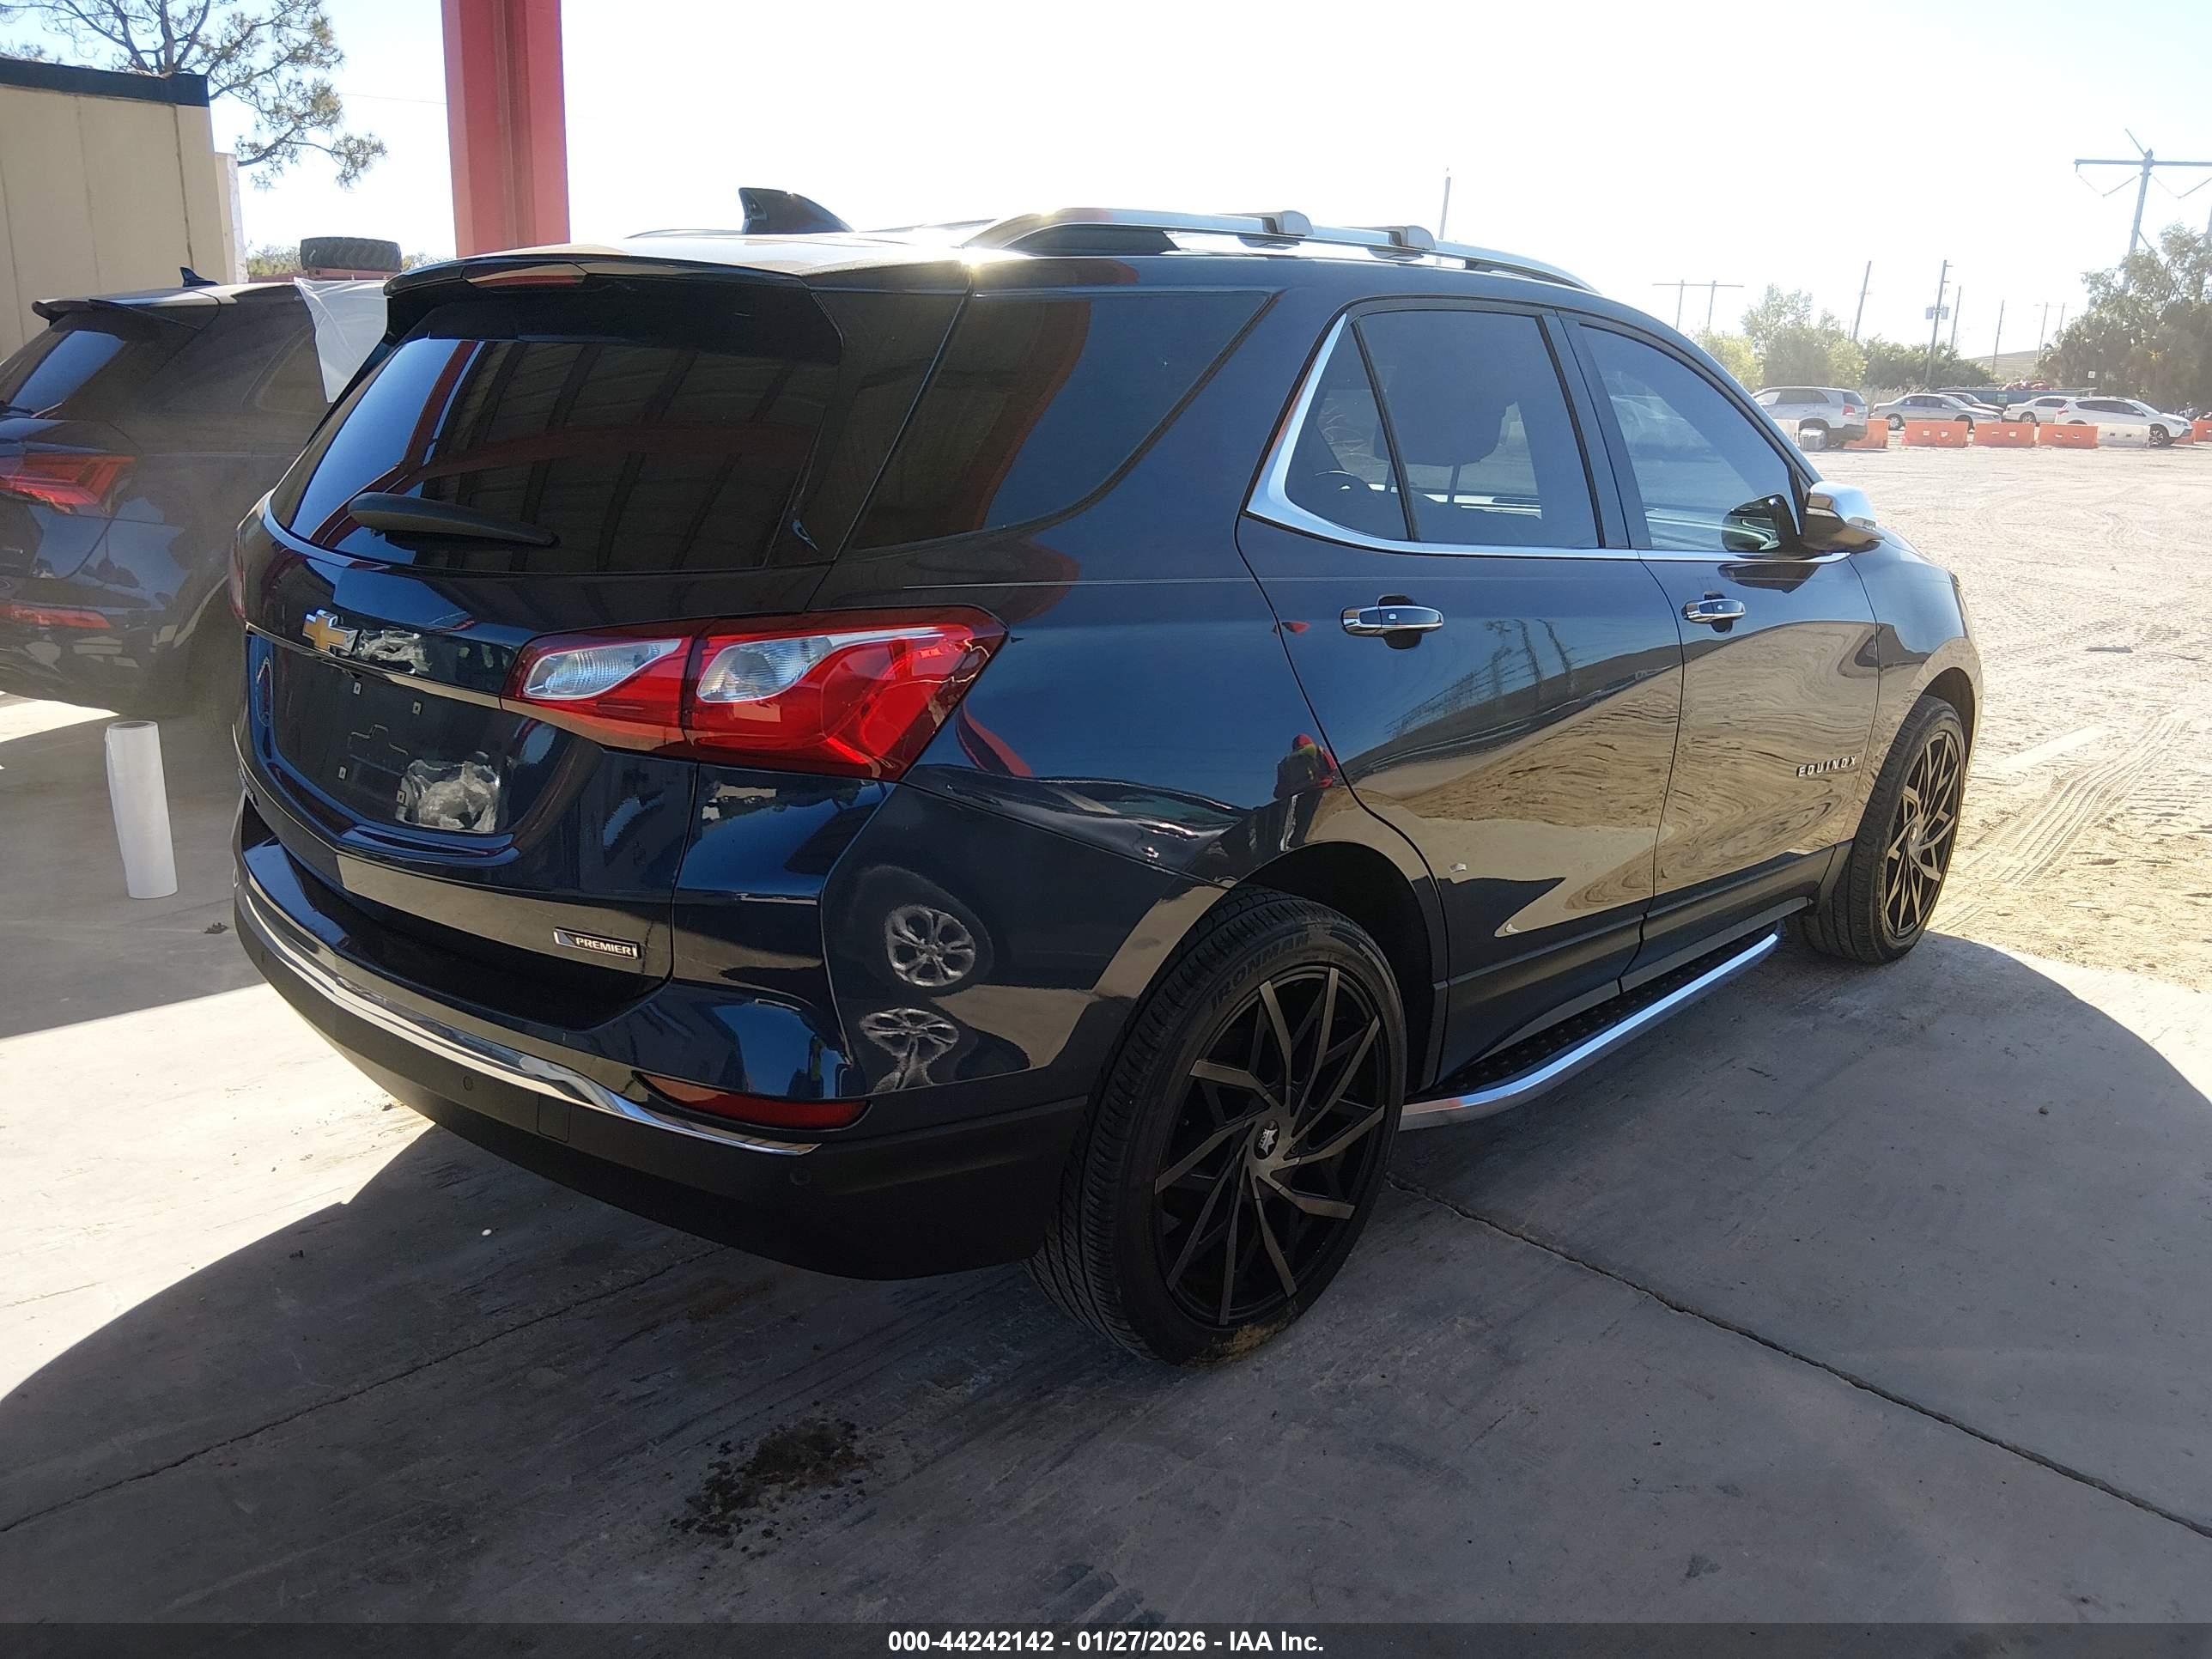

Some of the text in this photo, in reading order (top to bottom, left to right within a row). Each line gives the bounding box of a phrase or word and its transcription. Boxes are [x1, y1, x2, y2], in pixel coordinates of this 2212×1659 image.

[1796, 756, 1856, 777] EQUINOX
[575, 937, 632, 956] PREMIER
[1212, 933, 1310, 1012] IRONMAN
